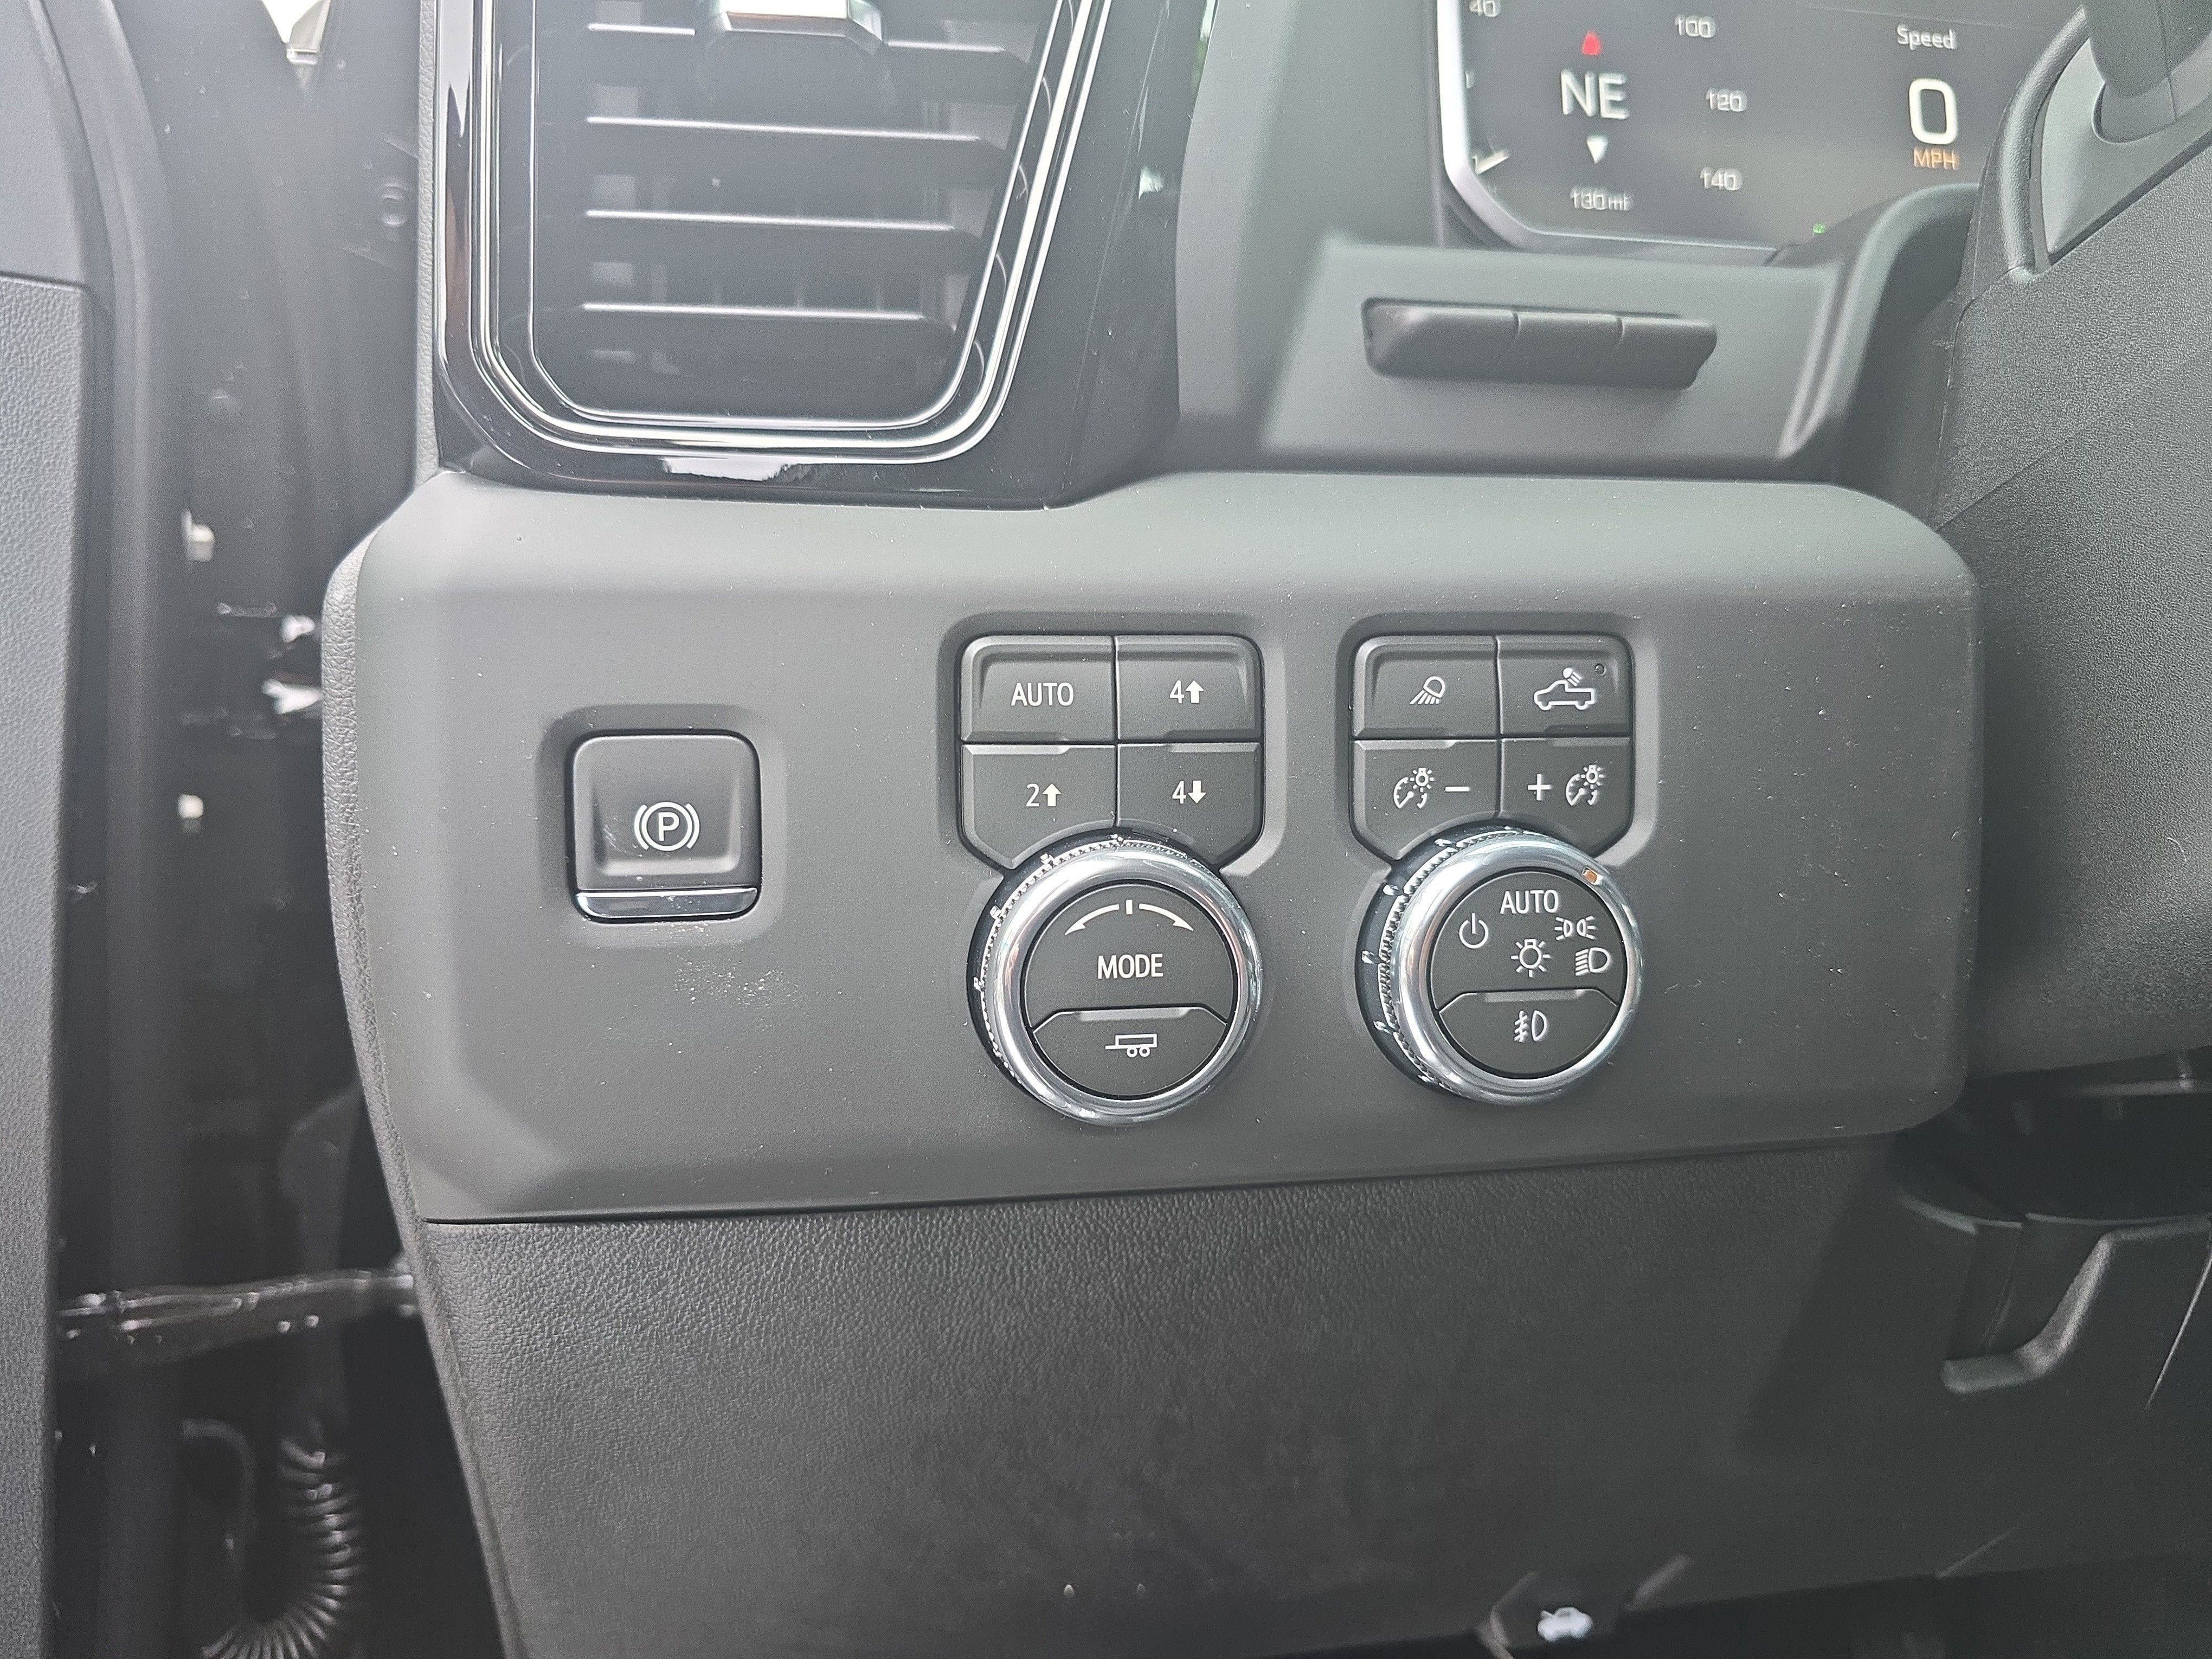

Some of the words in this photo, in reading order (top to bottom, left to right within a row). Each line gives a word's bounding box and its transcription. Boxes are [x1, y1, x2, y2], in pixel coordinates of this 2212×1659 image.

[1675, 14, 1716, 38] 100
[1897, 24, 1958, 50] Speed
[1560, 68, 1629, 120] NE
[1706, 88, 1747, 112] 120
[1908, 78, 1958, 144] 0
[1913, 147, 1960, 170] MPH
[1700, 167, 1742, 191] 140
[1011, 682, 1074, 706] AUTO
[1169, 680, 1185, 704] 4
[1026, 783, 1040, 807] 2
[1172, 781, 1186, 804] 4
[1500, 889, 1559, 915] AUTO
[1097, 953, 1163, 979] MODE
